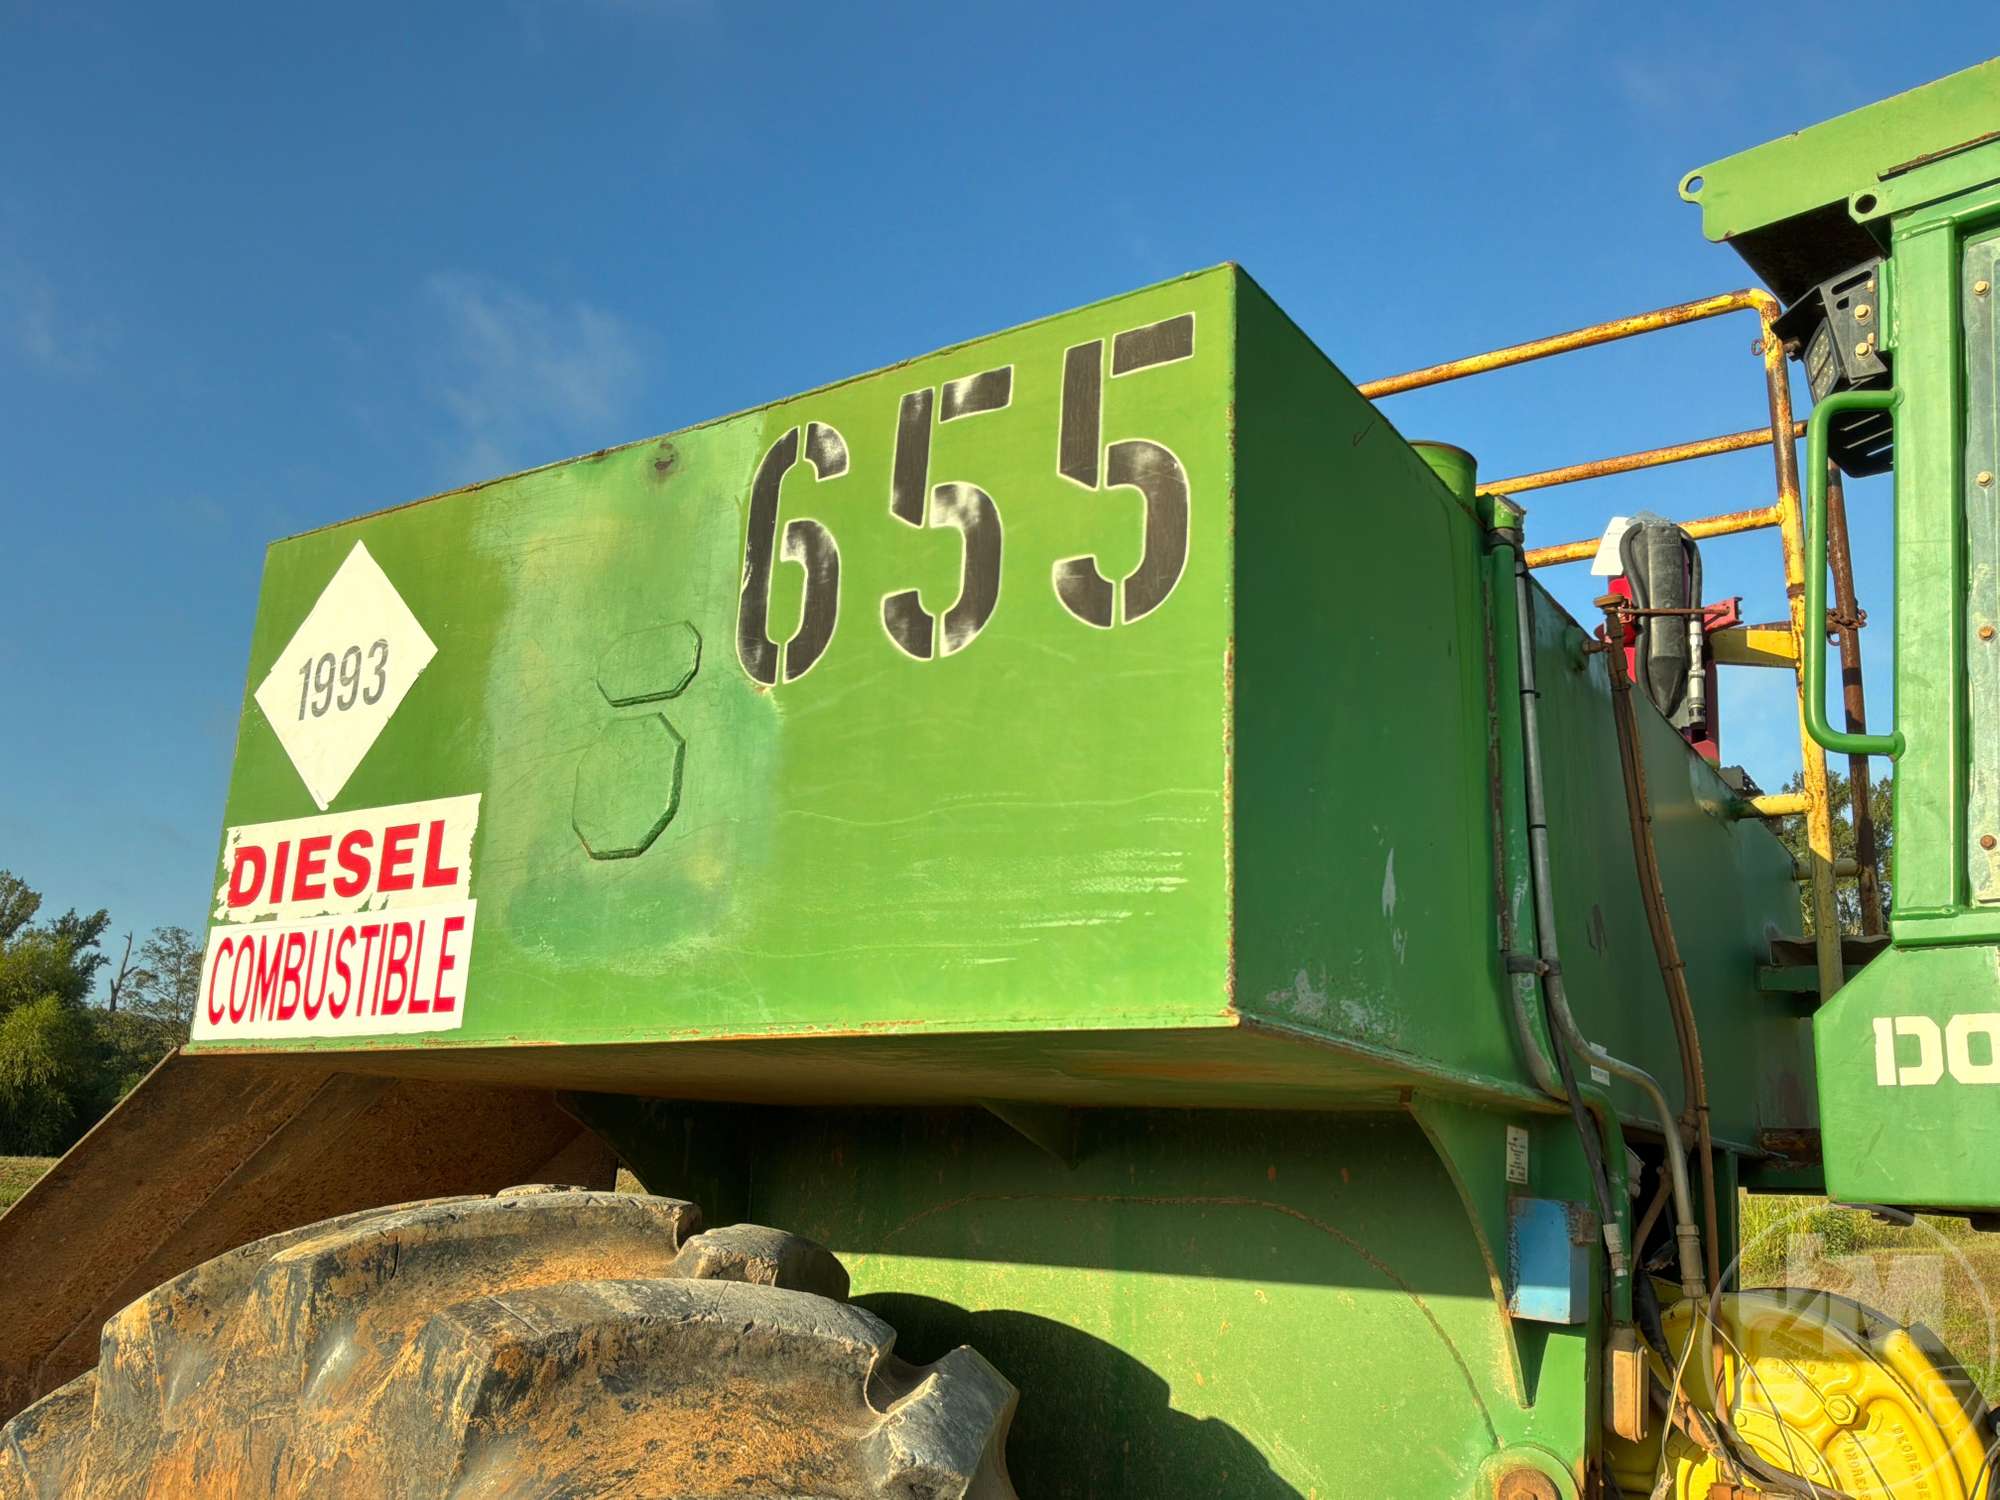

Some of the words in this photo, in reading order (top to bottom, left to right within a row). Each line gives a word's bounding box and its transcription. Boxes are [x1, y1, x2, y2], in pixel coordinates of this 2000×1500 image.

[736, 311, 1196, 687] 655
[298, 638, 389, 721] 1993
[227, 819, 460, 908] DIESEL
[208, 916, 465, 1026] COMBUSTIBLE
